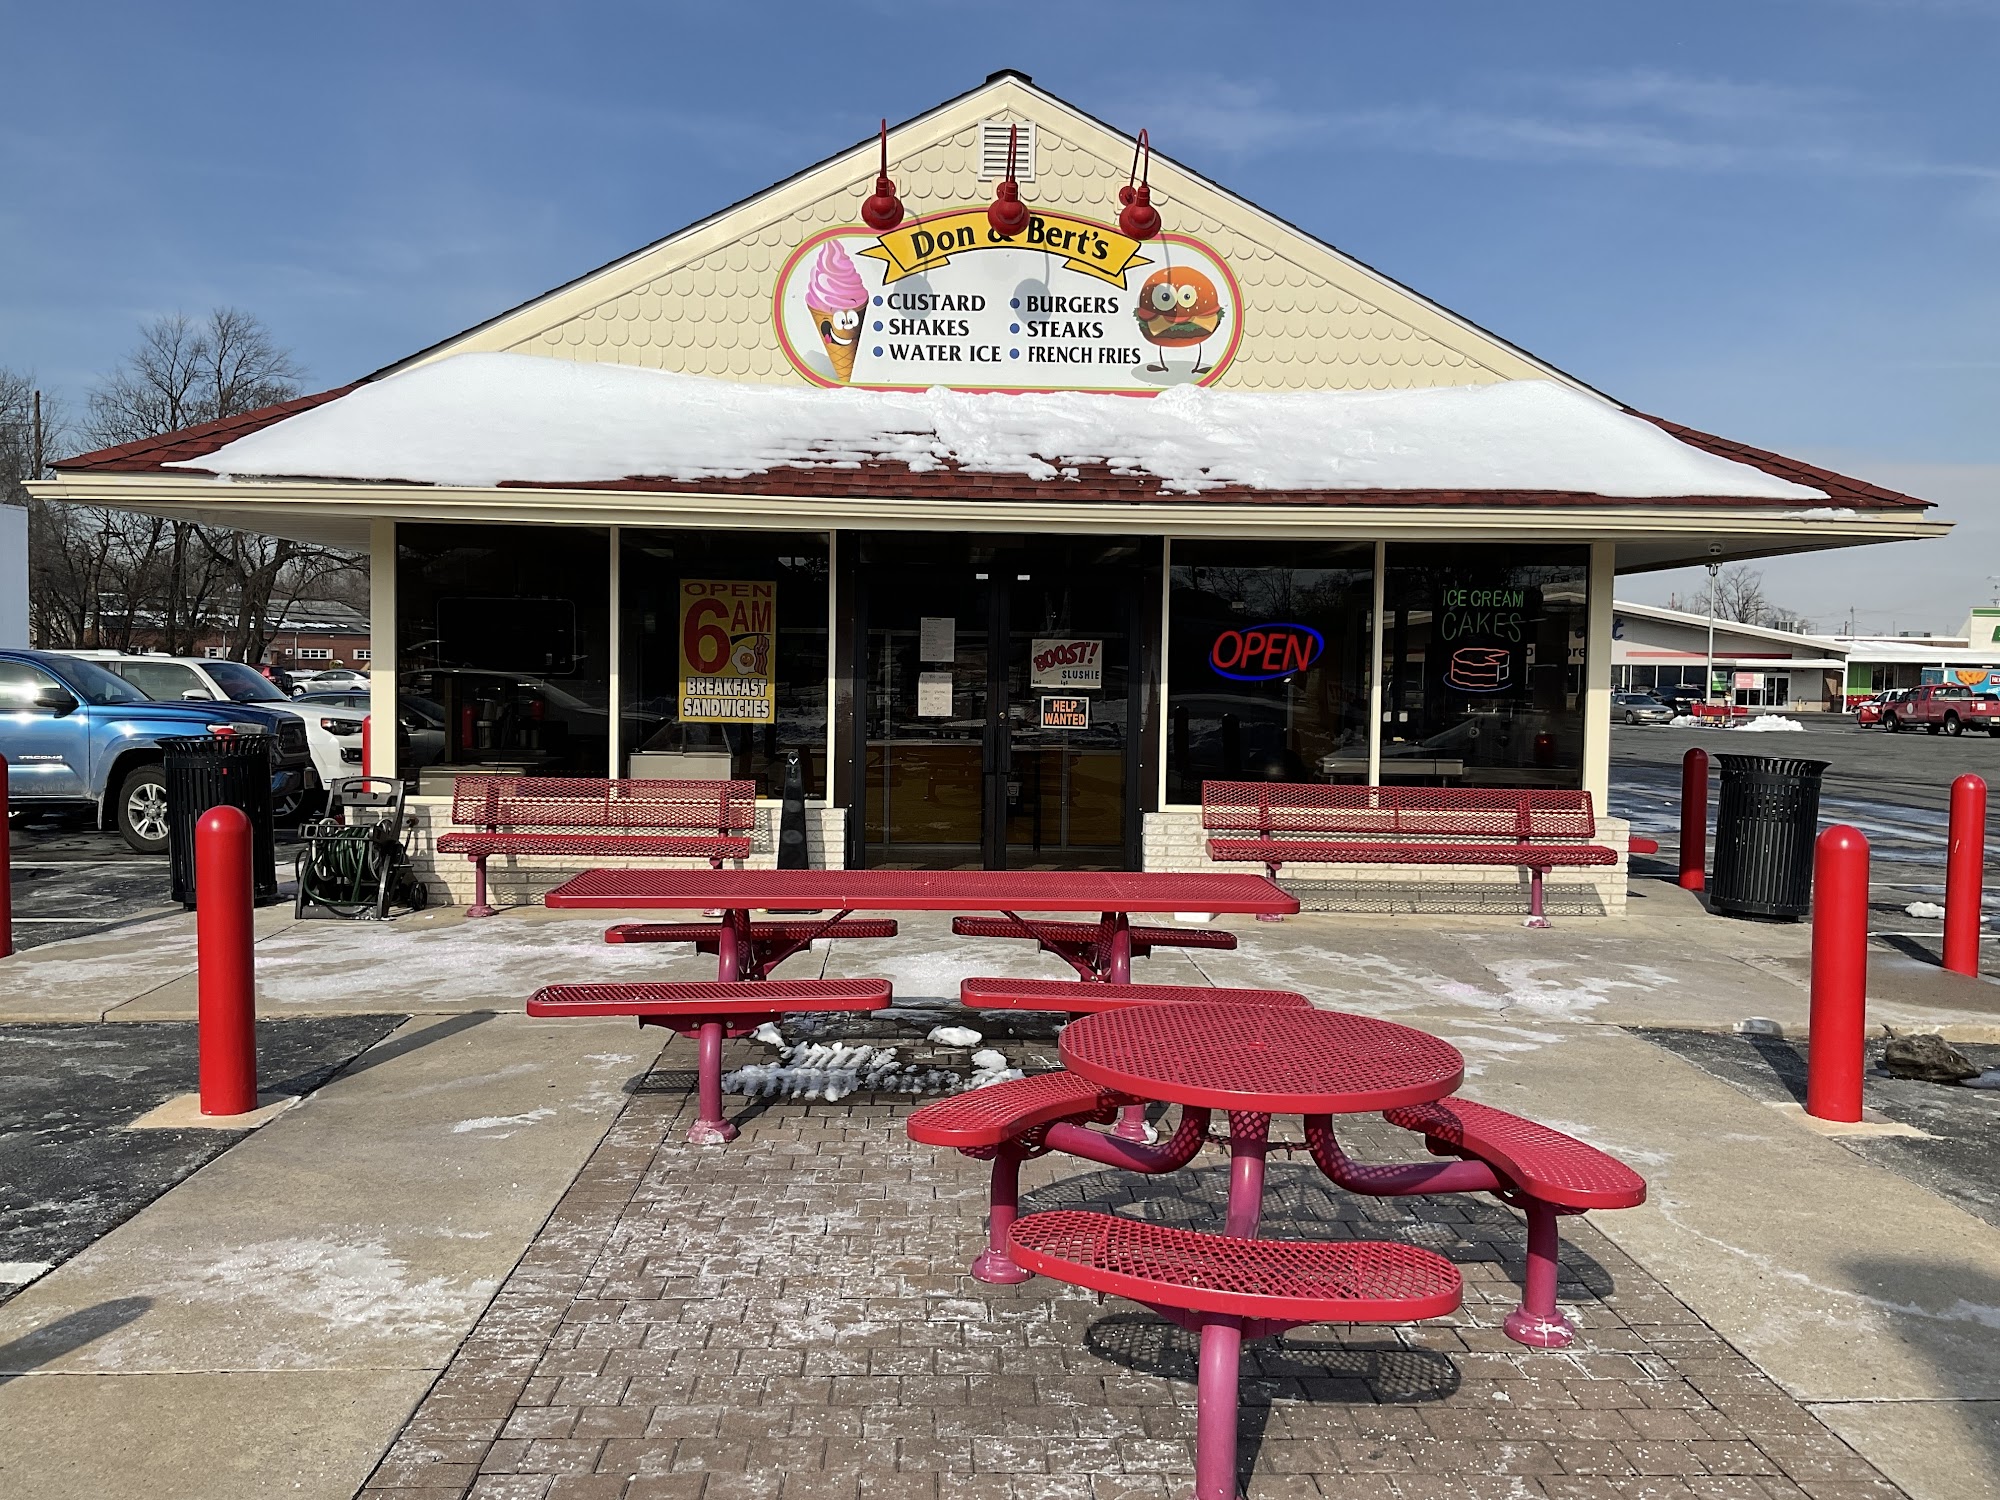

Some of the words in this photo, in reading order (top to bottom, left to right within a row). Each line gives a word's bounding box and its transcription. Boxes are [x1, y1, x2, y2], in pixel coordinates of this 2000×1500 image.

[910, 226, 976, 260] Don
[1026, 216, 1110, 261] Bert's
[886, 293, 986, 312] CUSTARD
[1026, 295, 1119, 314] BURGERS
[888, 318, 970, 337] SHAKES
[1026, 321, 1104, 339] STEAKS
[889, 344, 961, 362] WATER
[970, 345, 1002, 363] ICE
[1027, 346, 1093, 364] FRENCH
[1099, 347, 1141, 365] FRIES
[684, 583, 772, 598] OPEN
[1442, 589, 1468, 607] ICE
[1470, 589, 1525, 609] CREAM
[683, 598, 731, 674] 6
[730, 600, 772, 632] AM
[1441, 611, 1522, 643] CAKES
[1212, 630, 1314, 672] OPEN
[1062, 670, 1100, 680] SLUSHIE
[686, 677, 768, 697] BREAKFAST
[683, 698, 770, 718] SANDWICHES
[1052, 700, 1078, 712] HELP
[1044, 713, 1086, 726] WANTED
